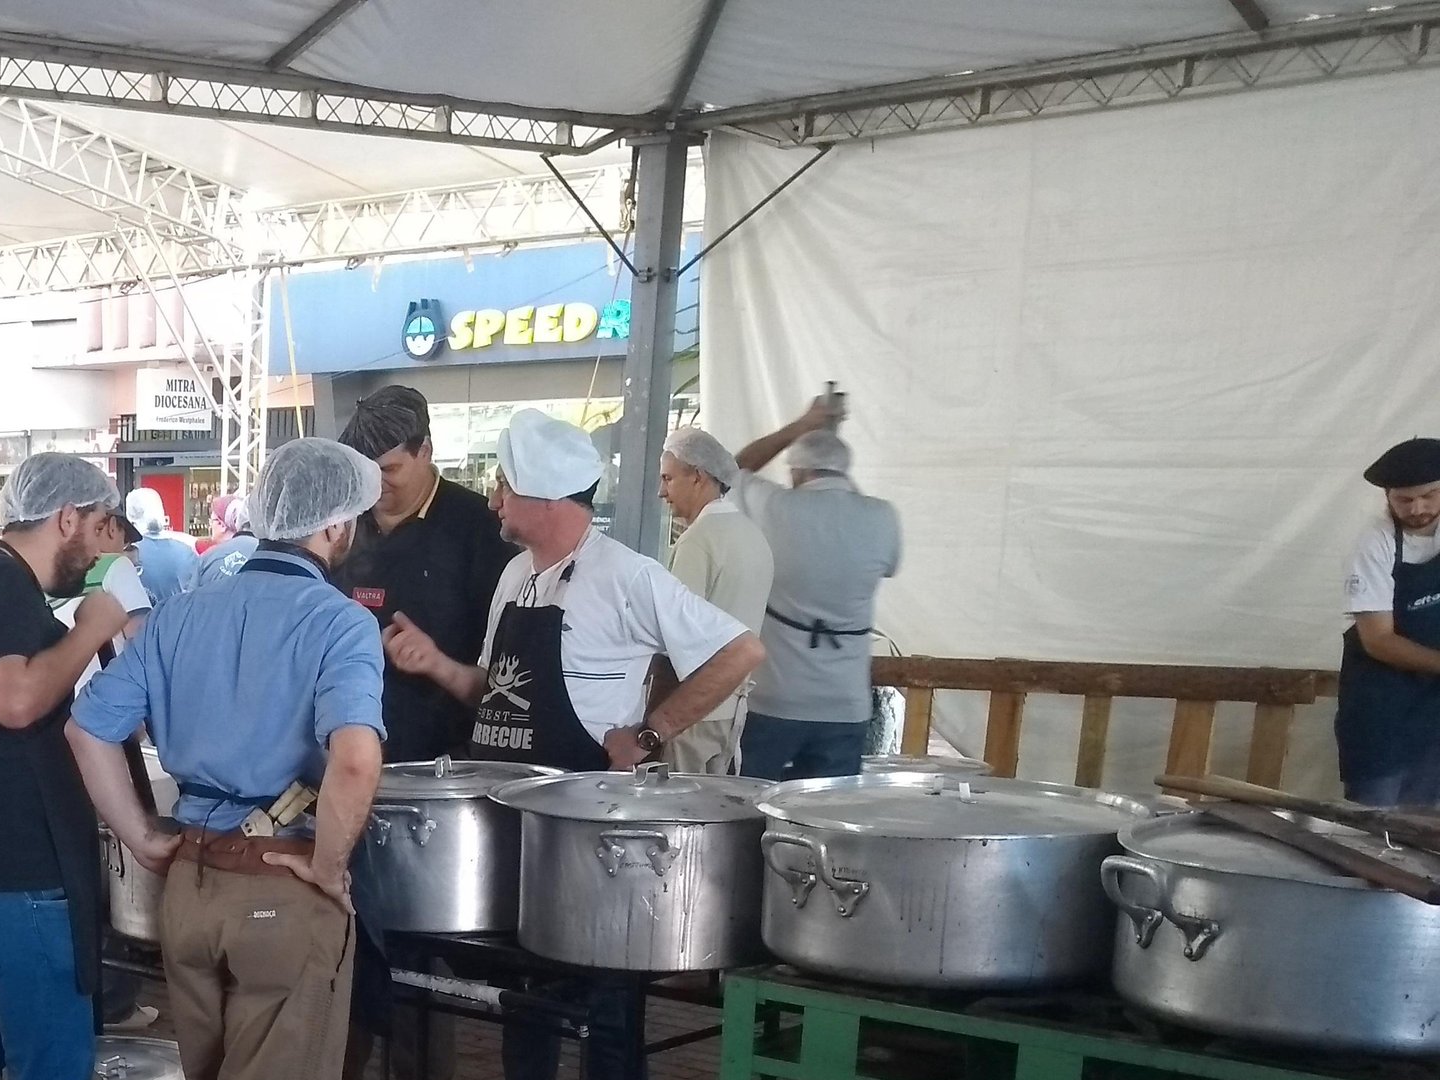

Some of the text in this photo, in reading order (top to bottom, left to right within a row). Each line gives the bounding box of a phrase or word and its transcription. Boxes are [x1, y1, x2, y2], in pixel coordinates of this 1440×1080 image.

[447, 302, 598, 350] SPEED
[165, 378, 196, 393] MITRA
[154, 394, 207, 410] DIOCESANA
[356, 591, 381, 600] VALTRA
